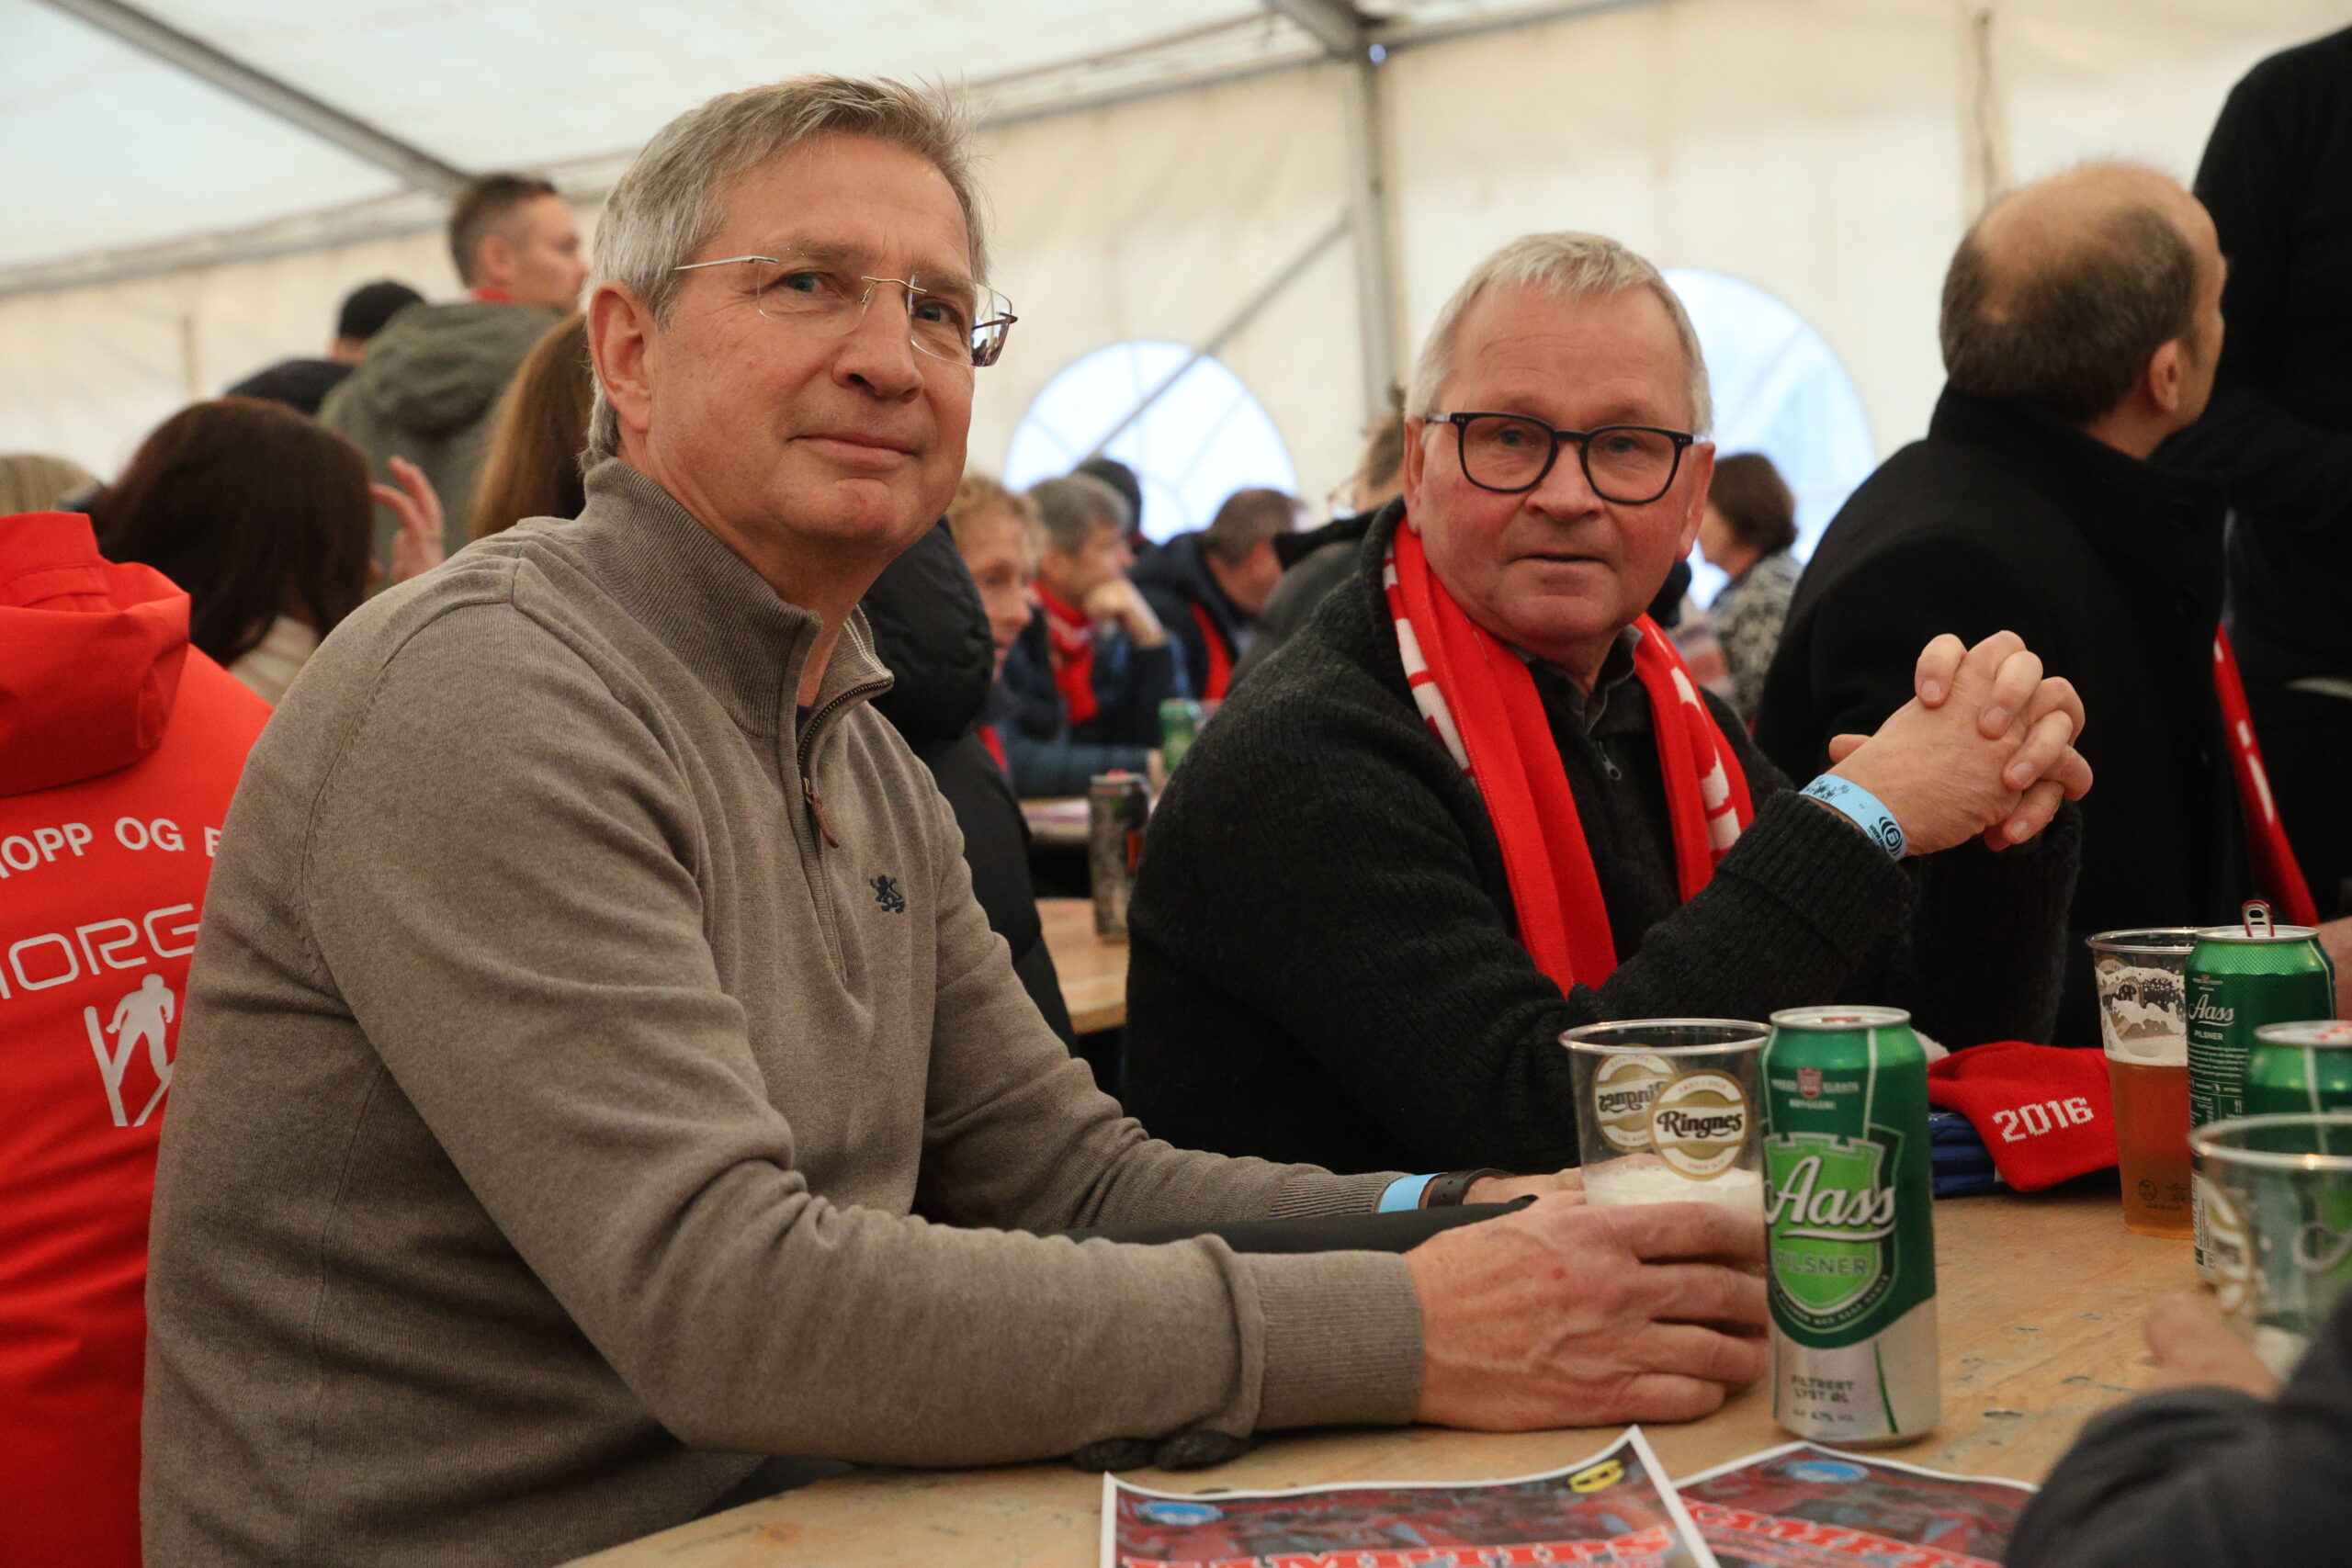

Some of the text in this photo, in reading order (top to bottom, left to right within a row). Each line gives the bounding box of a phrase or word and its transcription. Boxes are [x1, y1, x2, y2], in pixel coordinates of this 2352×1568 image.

[0, 823, 93, 878] OPP
[115, 817, 186, 852] OG
[0, 903, 200, 999] ORG
[2188, 994, 2235, 1026] Aass
[2194, 1030, 2224, 1041] PILSNER
[1657, 1110, 1743, 1139] Ringnes
[1992, 1097, 2095, 1144] 2016
[1764, 1155, 1897, 1241] Aass
